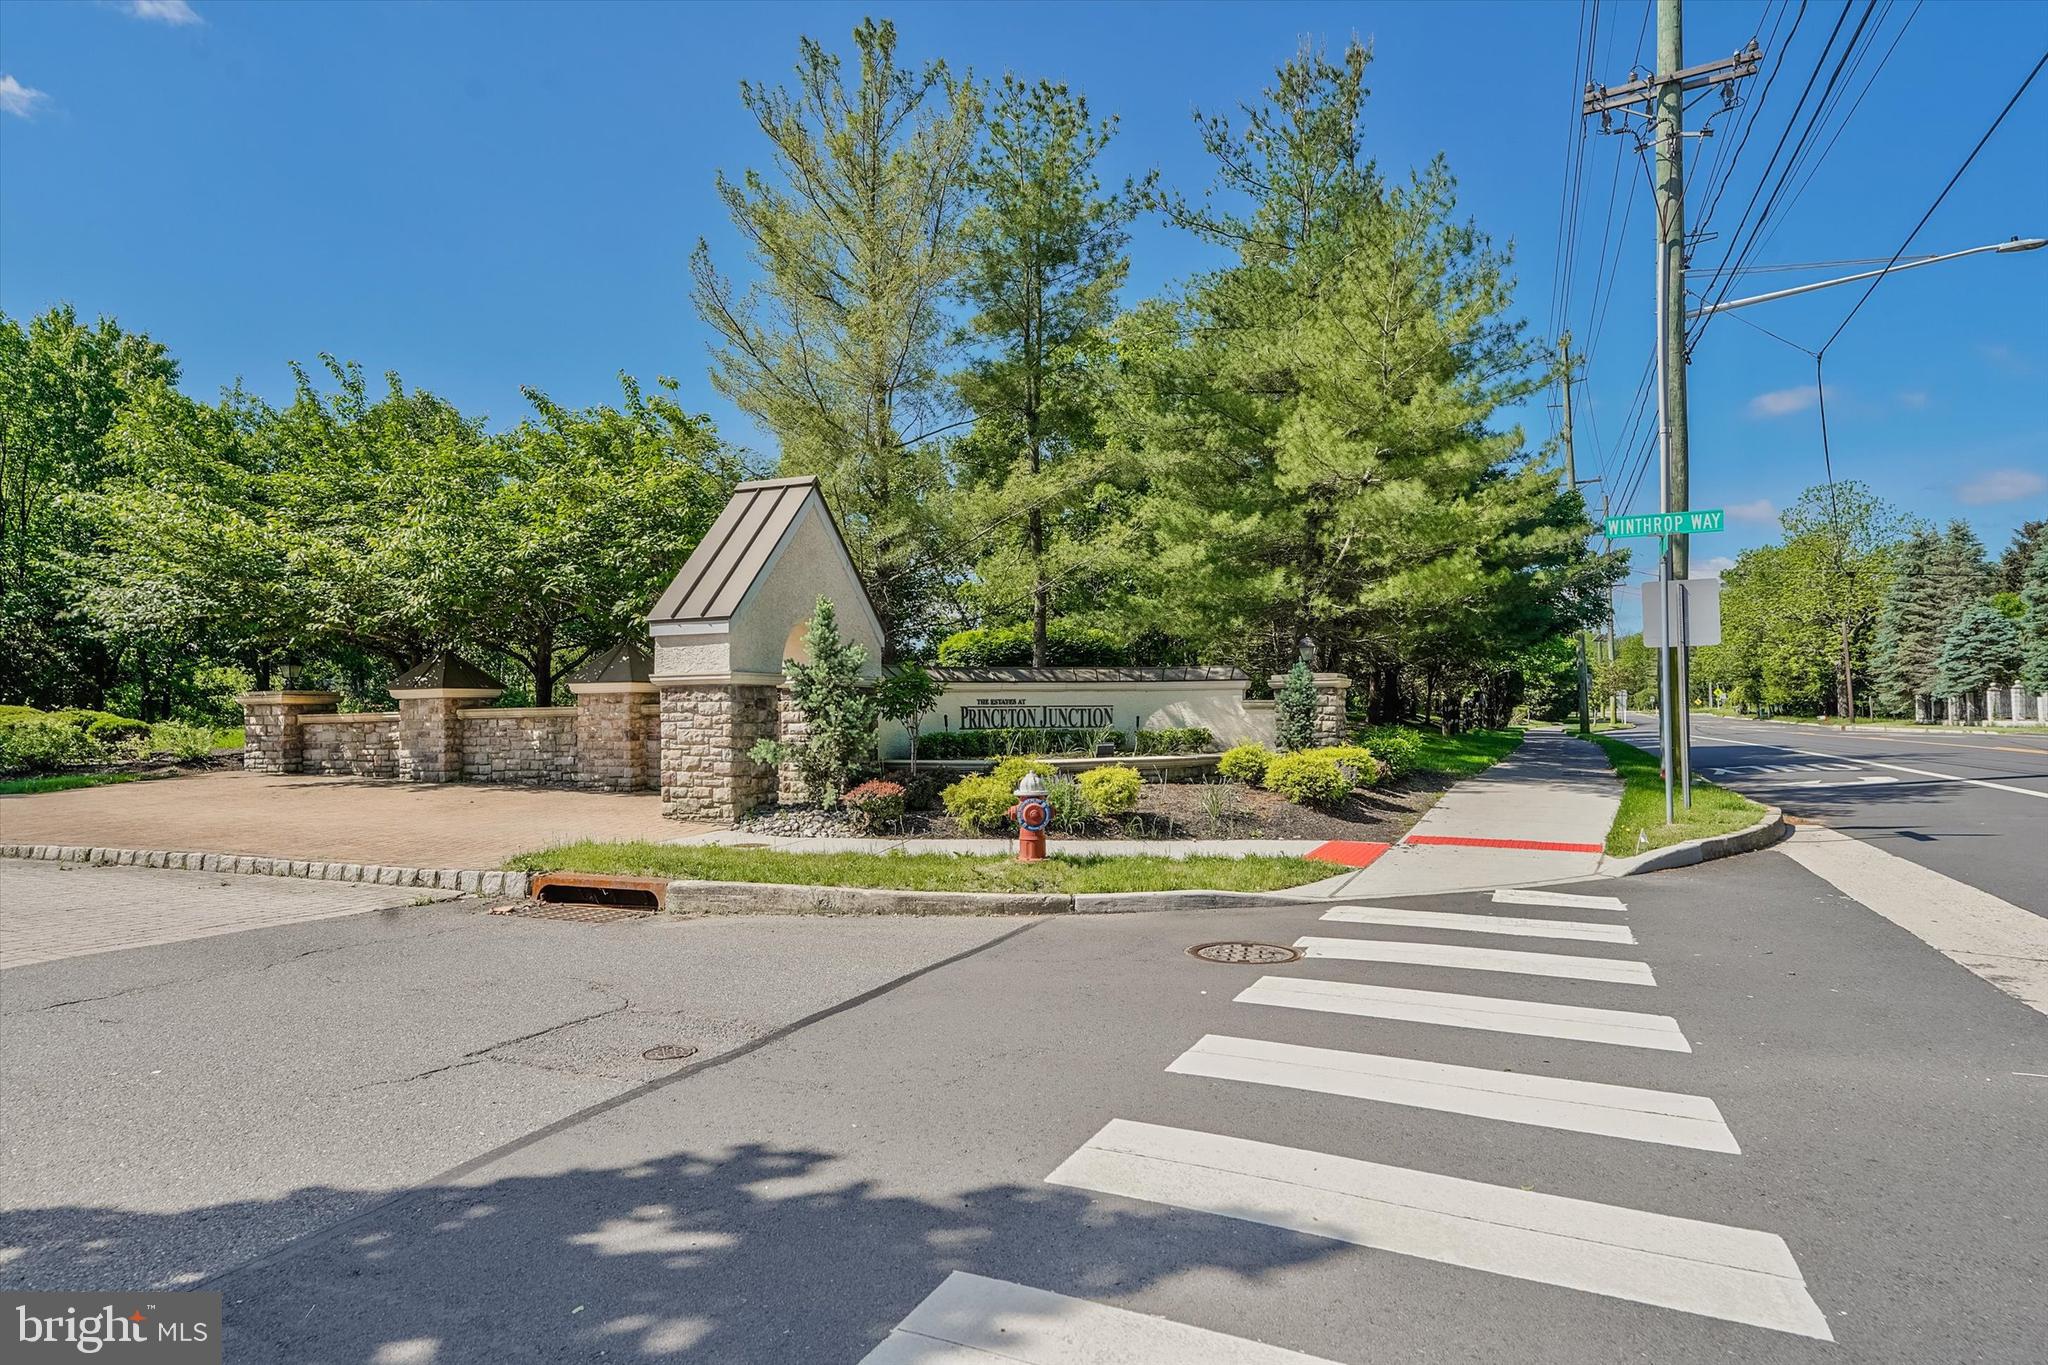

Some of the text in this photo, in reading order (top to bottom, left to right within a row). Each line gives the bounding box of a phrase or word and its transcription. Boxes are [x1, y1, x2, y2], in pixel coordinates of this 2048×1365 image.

[1608, 512, 1721, 535] WINTHROP WAY
[960, 706, 1114, 729] PRINCETON JUNCTION
